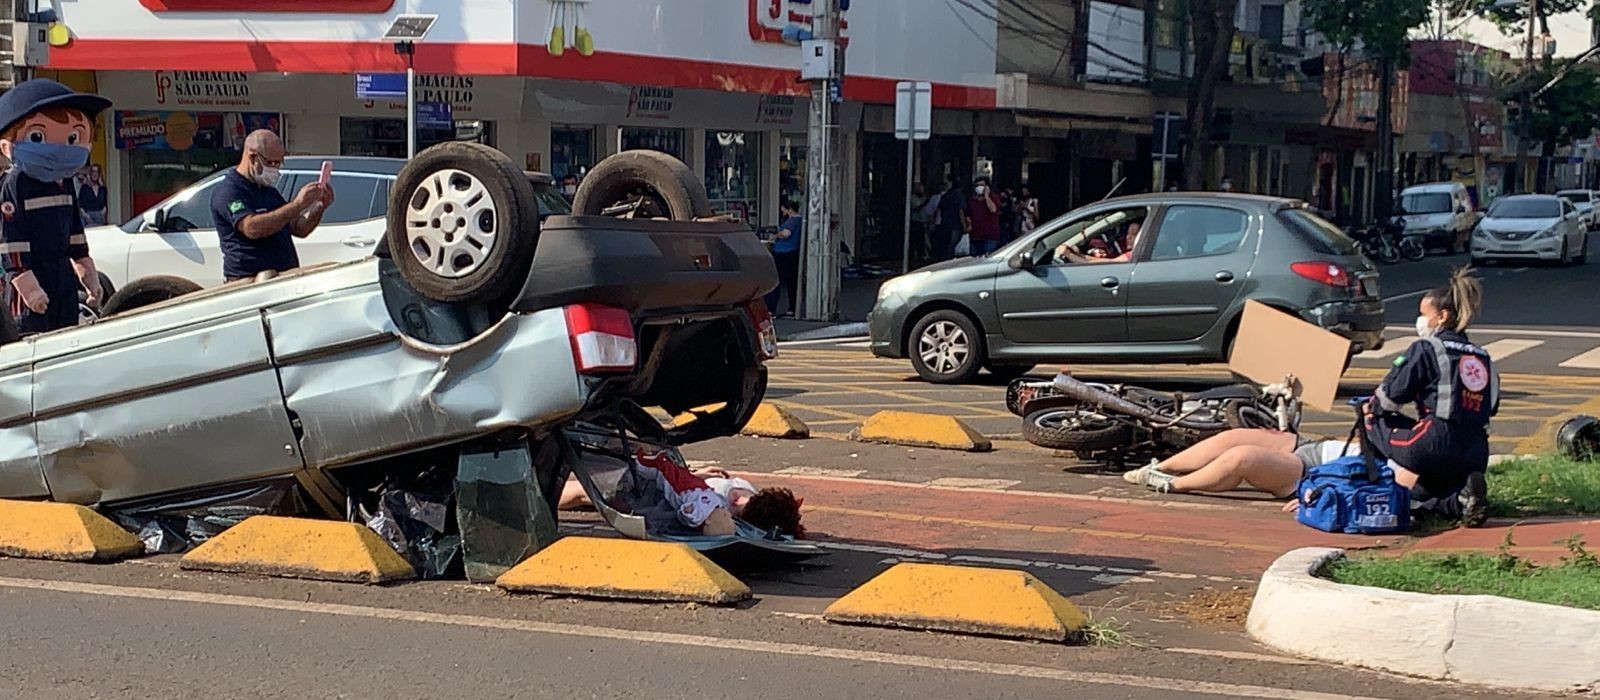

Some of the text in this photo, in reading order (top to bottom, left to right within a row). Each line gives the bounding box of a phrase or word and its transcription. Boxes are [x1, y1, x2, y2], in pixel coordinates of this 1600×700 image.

[205, 84, 249, 97] PAULO
[424, 90, 473, 103] PAULO
[119, 124, 165, 139] PREMIADO
[1366, 503, 1391, 515] 192
